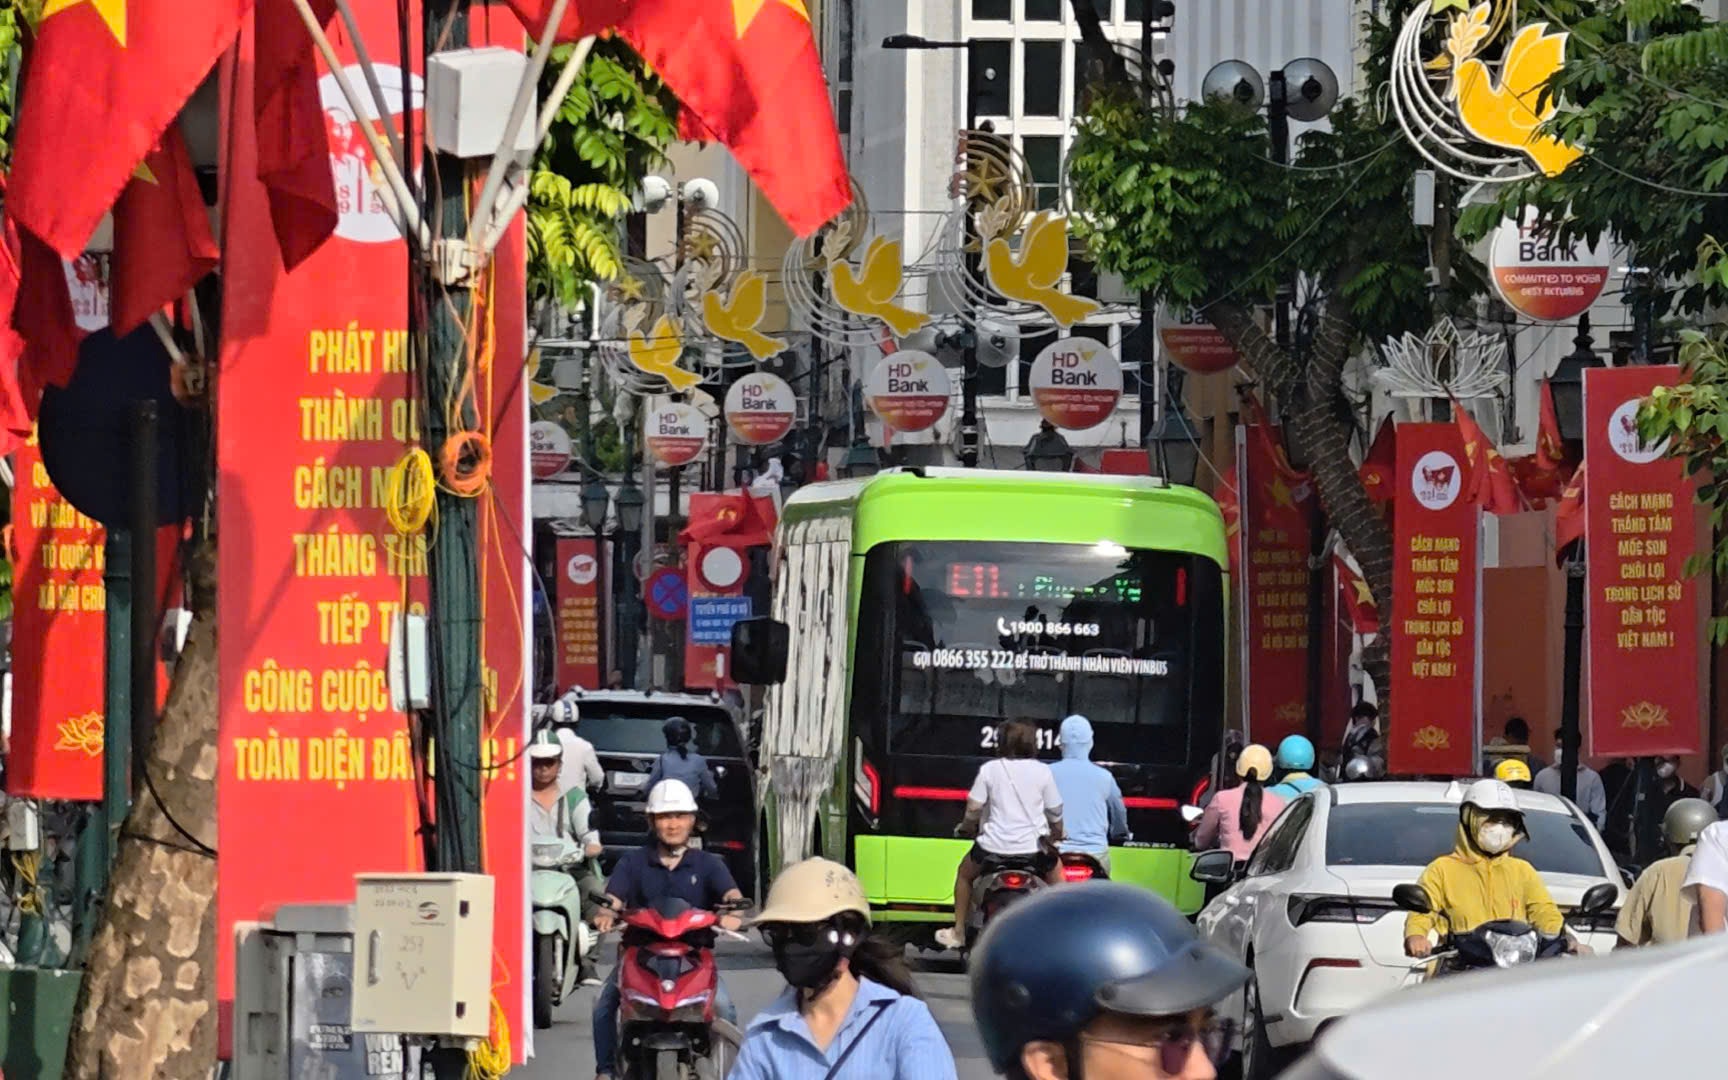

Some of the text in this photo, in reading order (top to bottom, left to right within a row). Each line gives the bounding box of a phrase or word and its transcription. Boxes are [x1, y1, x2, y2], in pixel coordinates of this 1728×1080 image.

[1519, 241, 1579, 262] Bank
[1560, 274, 1573, 284] TO
[310, 321, 375, 373] PHÁT
[888, 363, 912, 378] HD
[1052, 352, 1080, 368] HD
[888, 379, 929, 393] Bank
[1051, 369, 1098, 386] Bank
[742, 384, 763, 397] HD
[300, 388, 383, 441] THÀNH
[742, 398, 777, 410] Bank
[659, 413, 678, 424] HD
[659, 424, 690, 435] Bank
[294, 457, 363, 508] CÁCH
[1609, 491, 1673, 513] CÁCH MẠNG
[1611, 514, 1672, 534] THÁNG TÁM
[293, 524, 376, 576] THÁNG
[1645, 539, 1667, 556] SON
[1604, 580, 1682, 604] TRONG LỊCH SỬ
[317, 592, 370, 644] TIẾP
[1621, 605, 1666, 628] DÂN TỘC
[1010, 621, 1100, 636] 1900 866 663
[1617, 629, 1638, 652] VIỆT
[1641, 631, 1667, 648] NAM
[913, 649, 1168, 675] GỌI 0866 355 222 ĐỂ TRỞ THÀNH NHÂN VIÊN VINBUS
[244, 658, 388, 721] CÔNG CUỘC
[234, 728, 300, 780] TOÀN
[308, 728, 365, 790] DIỆN
